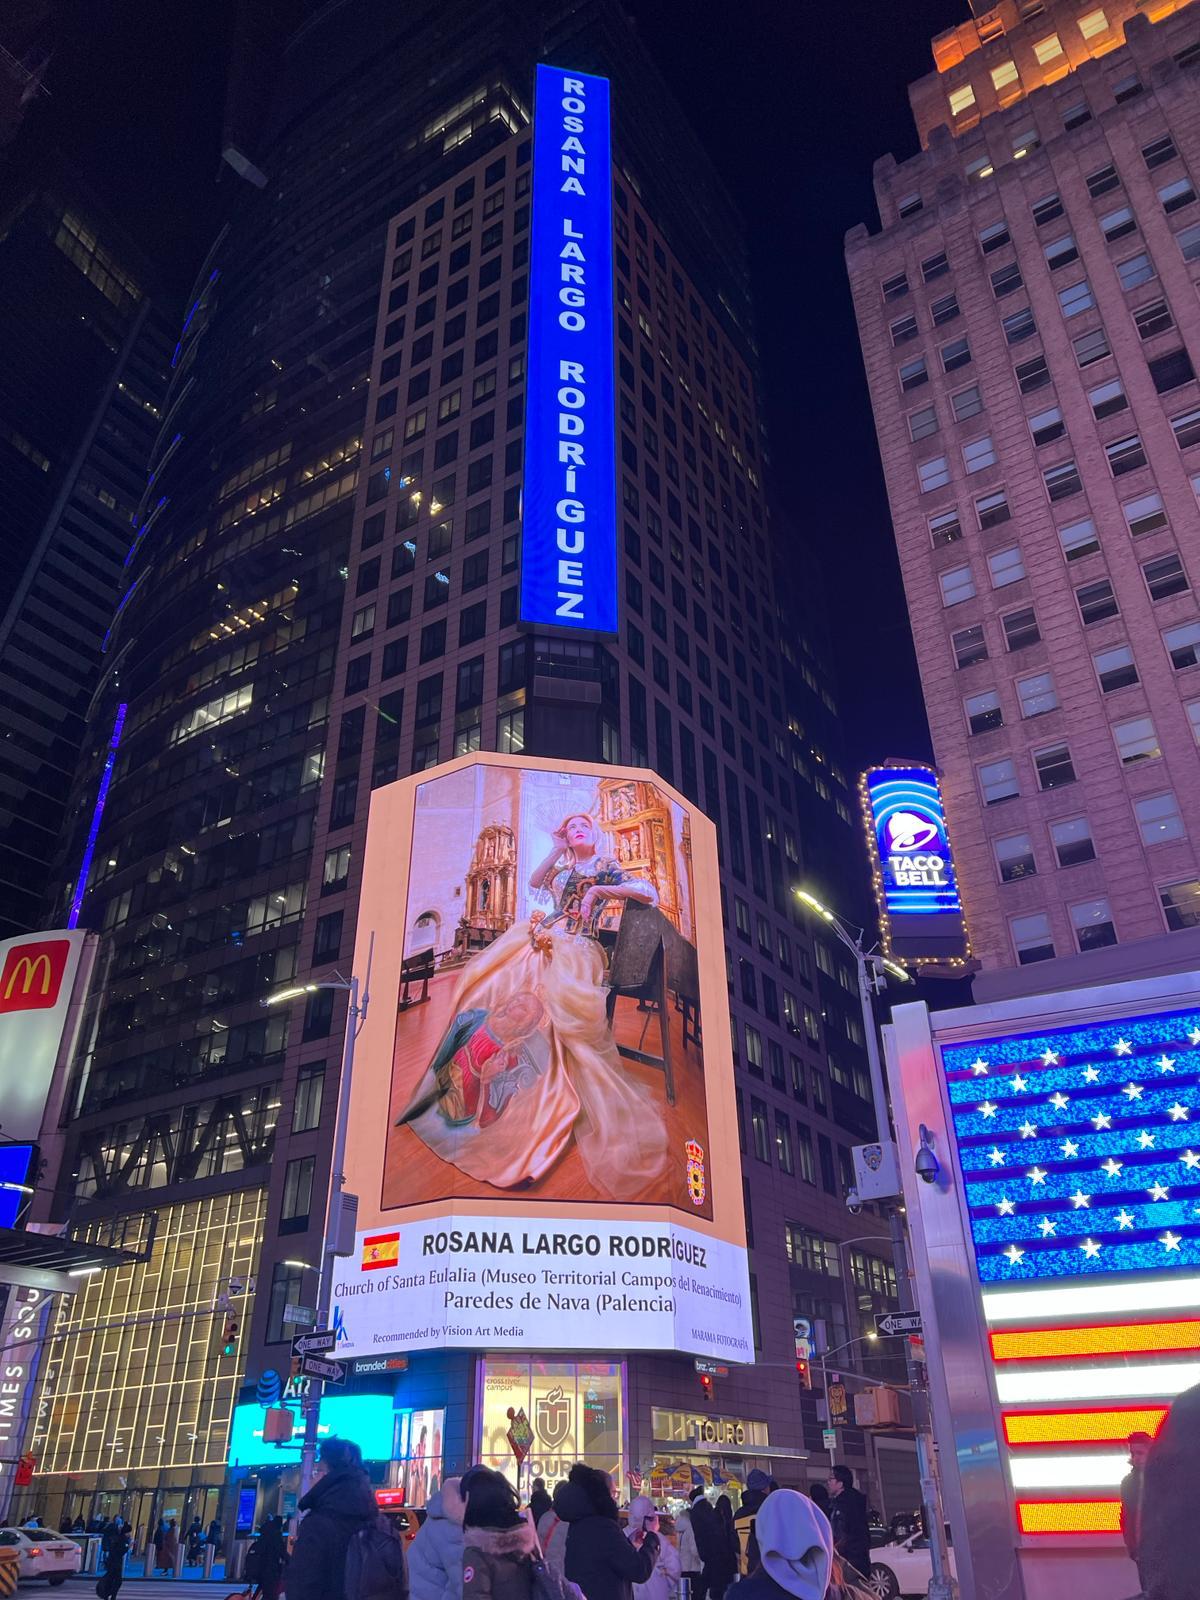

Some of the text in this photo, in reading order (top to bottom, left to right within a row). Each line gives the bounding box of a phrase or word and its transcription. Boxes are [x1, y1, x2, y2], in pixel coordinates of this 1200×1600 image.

[555, 77, 586, 619] ROSANA LARGO RODRÍGUEZ
[888, 855, 944, 871] TACO
[895, 871, 949, 886] BELL
[422, 1231, 707, 1268] ROSANA LARGO RODRÍGUEZ
[334, 1268, 742, 1307] Church of Santa Eulalia (Museo Territorial Campos del Renacimiento)
[444, 1291, 677, 1316] Paredes de Nava (Palencia)
[373, 1325, 524, 1344] Recommended by Vision Art Media
[885, 1319, 902, 1330] ONE
[298, 1339, 312, 1350] ONE
[317, 1336, 332, 1347] WAY
[691, 1328, 749, 1350] MARAMA FOTOGRAFÍA
[308, 1360, 340, 1377] ONE WAY
[695, 1419, 745, 1445] TOURO
